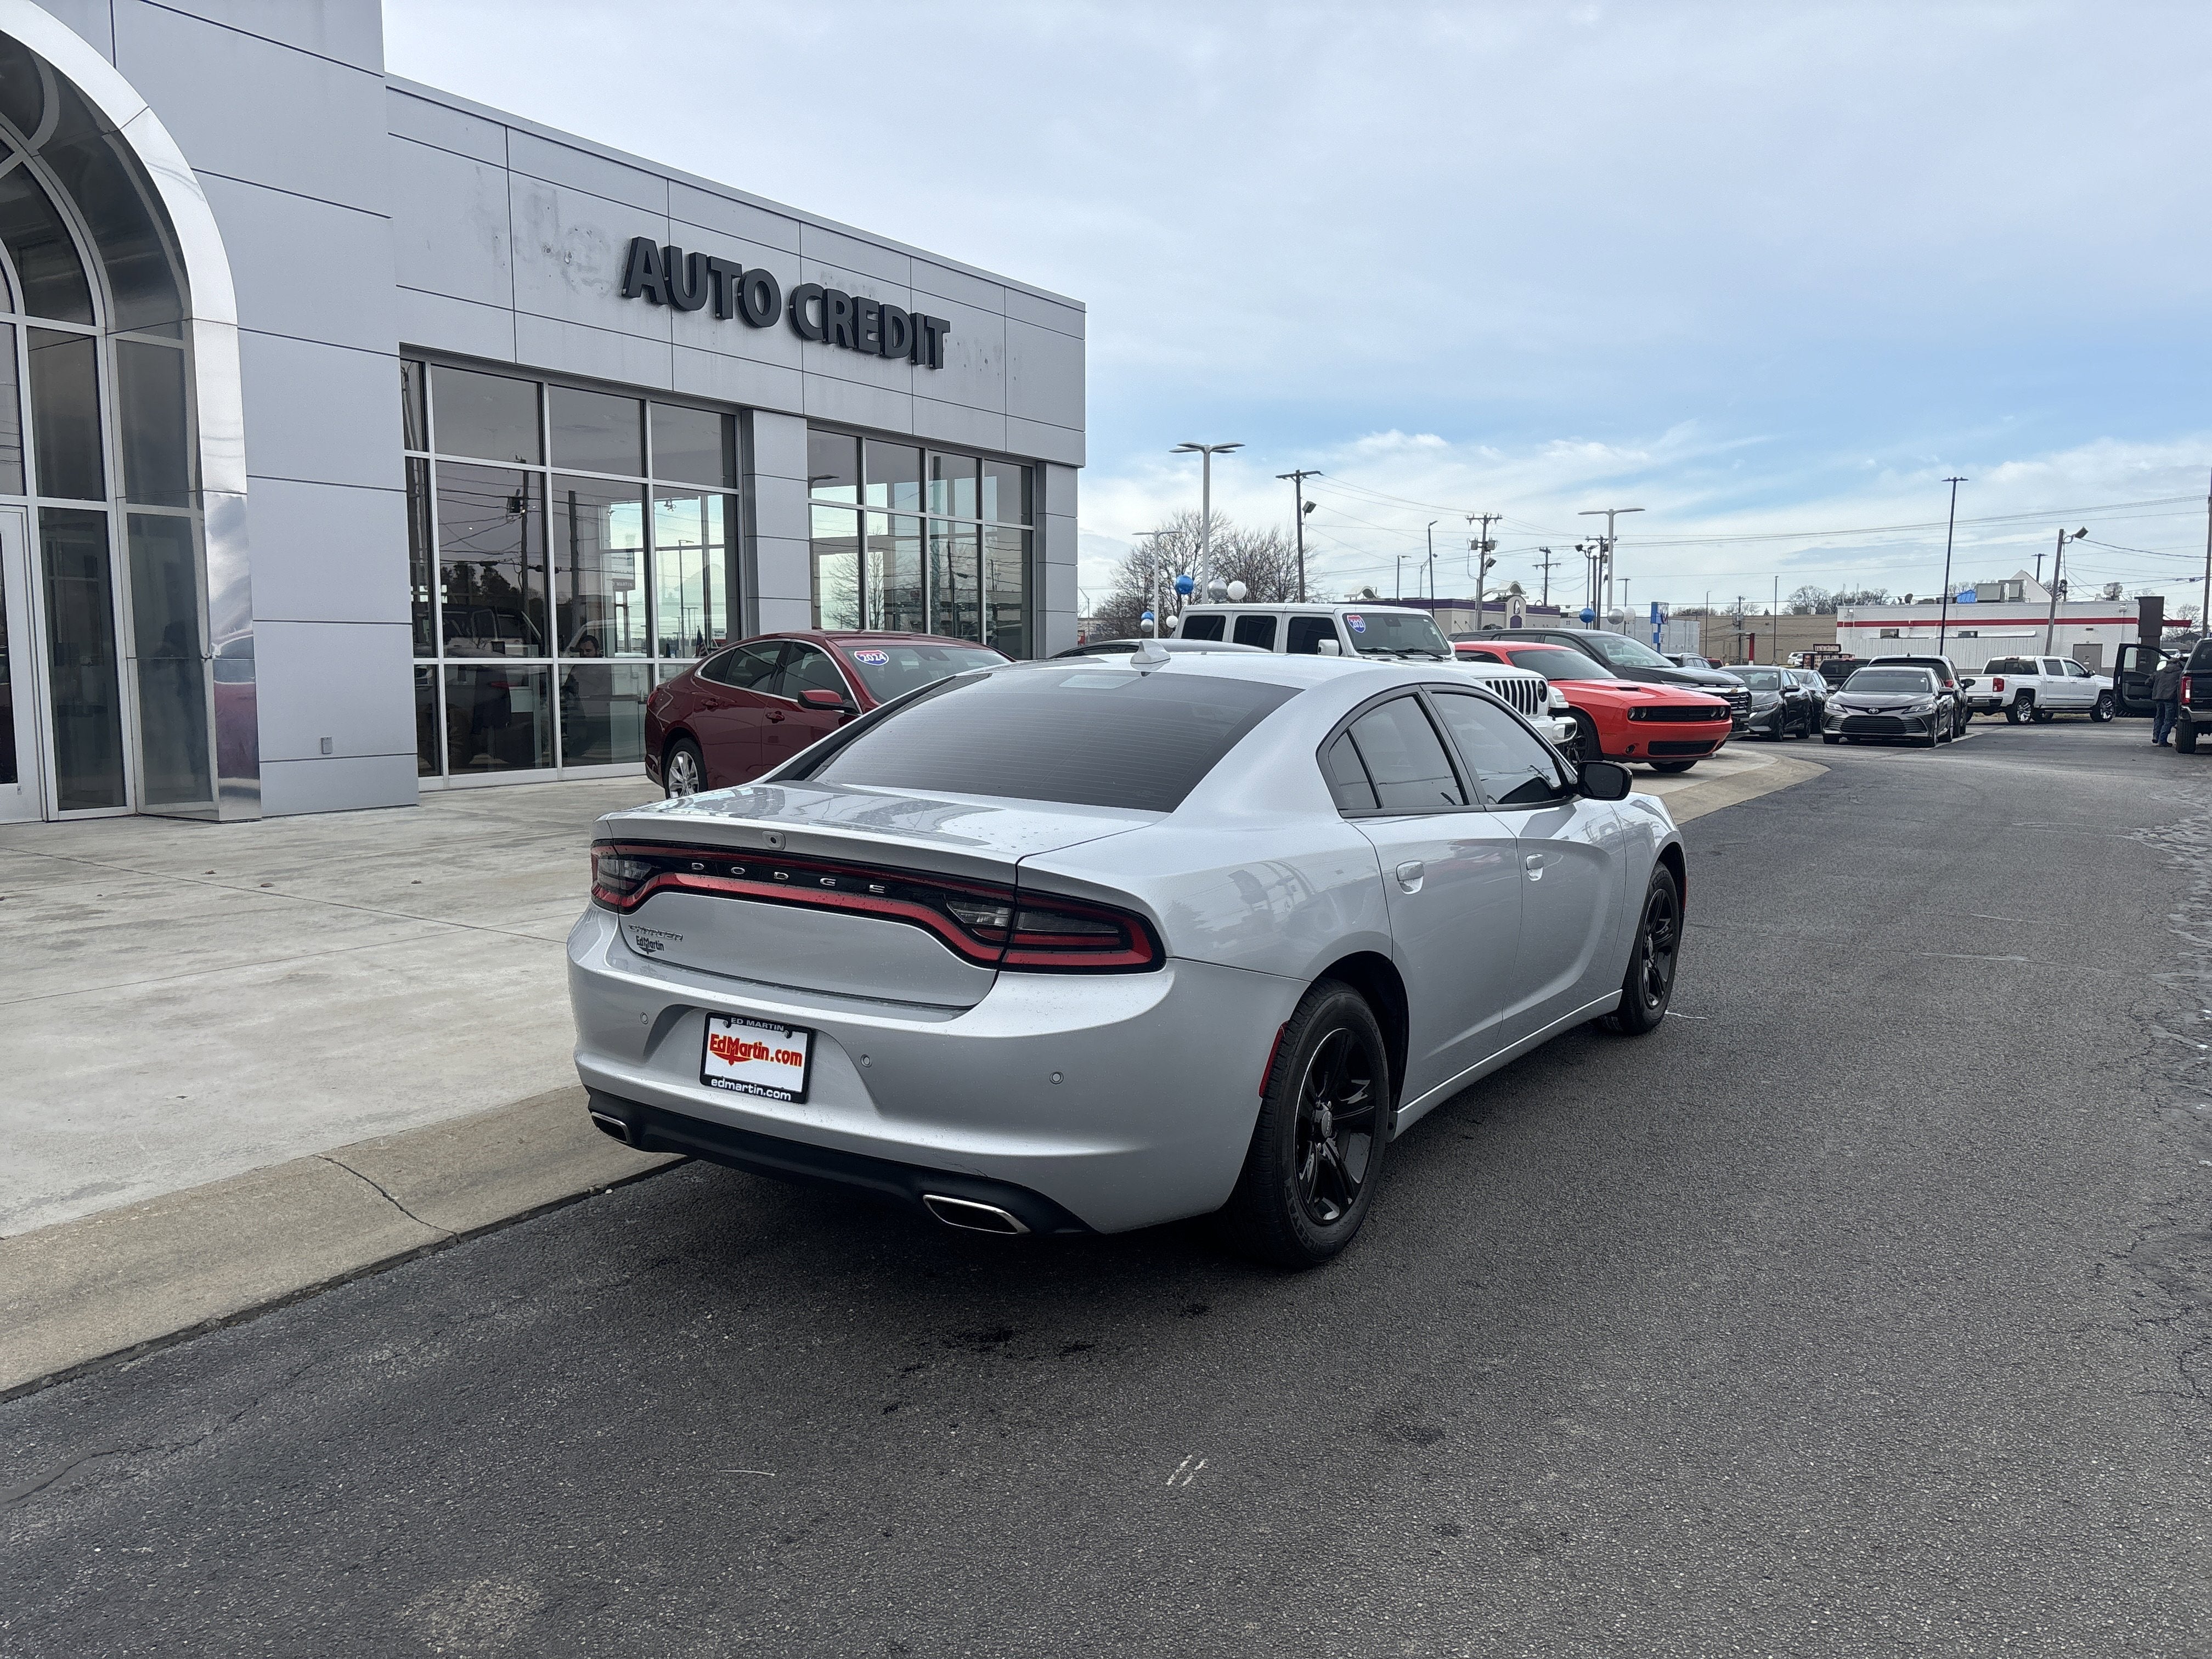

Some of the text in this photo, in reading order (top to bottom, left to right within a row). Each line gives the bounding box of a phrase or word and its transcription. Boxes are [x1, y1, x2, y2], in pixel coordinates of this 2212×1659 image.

[622, 236, 950, 369] AUTO CREDIT
[1350, 619, 1364, 628] 2021
[859, 653, 887, 662] 2024
[691, 862, 885, 893] DODGE
[746, 1019, 784, 1031] MARTIN
[710, 1033, 803, 1068] EdMartin.com
[711, 1077, 792, 1101] edmartin.com
